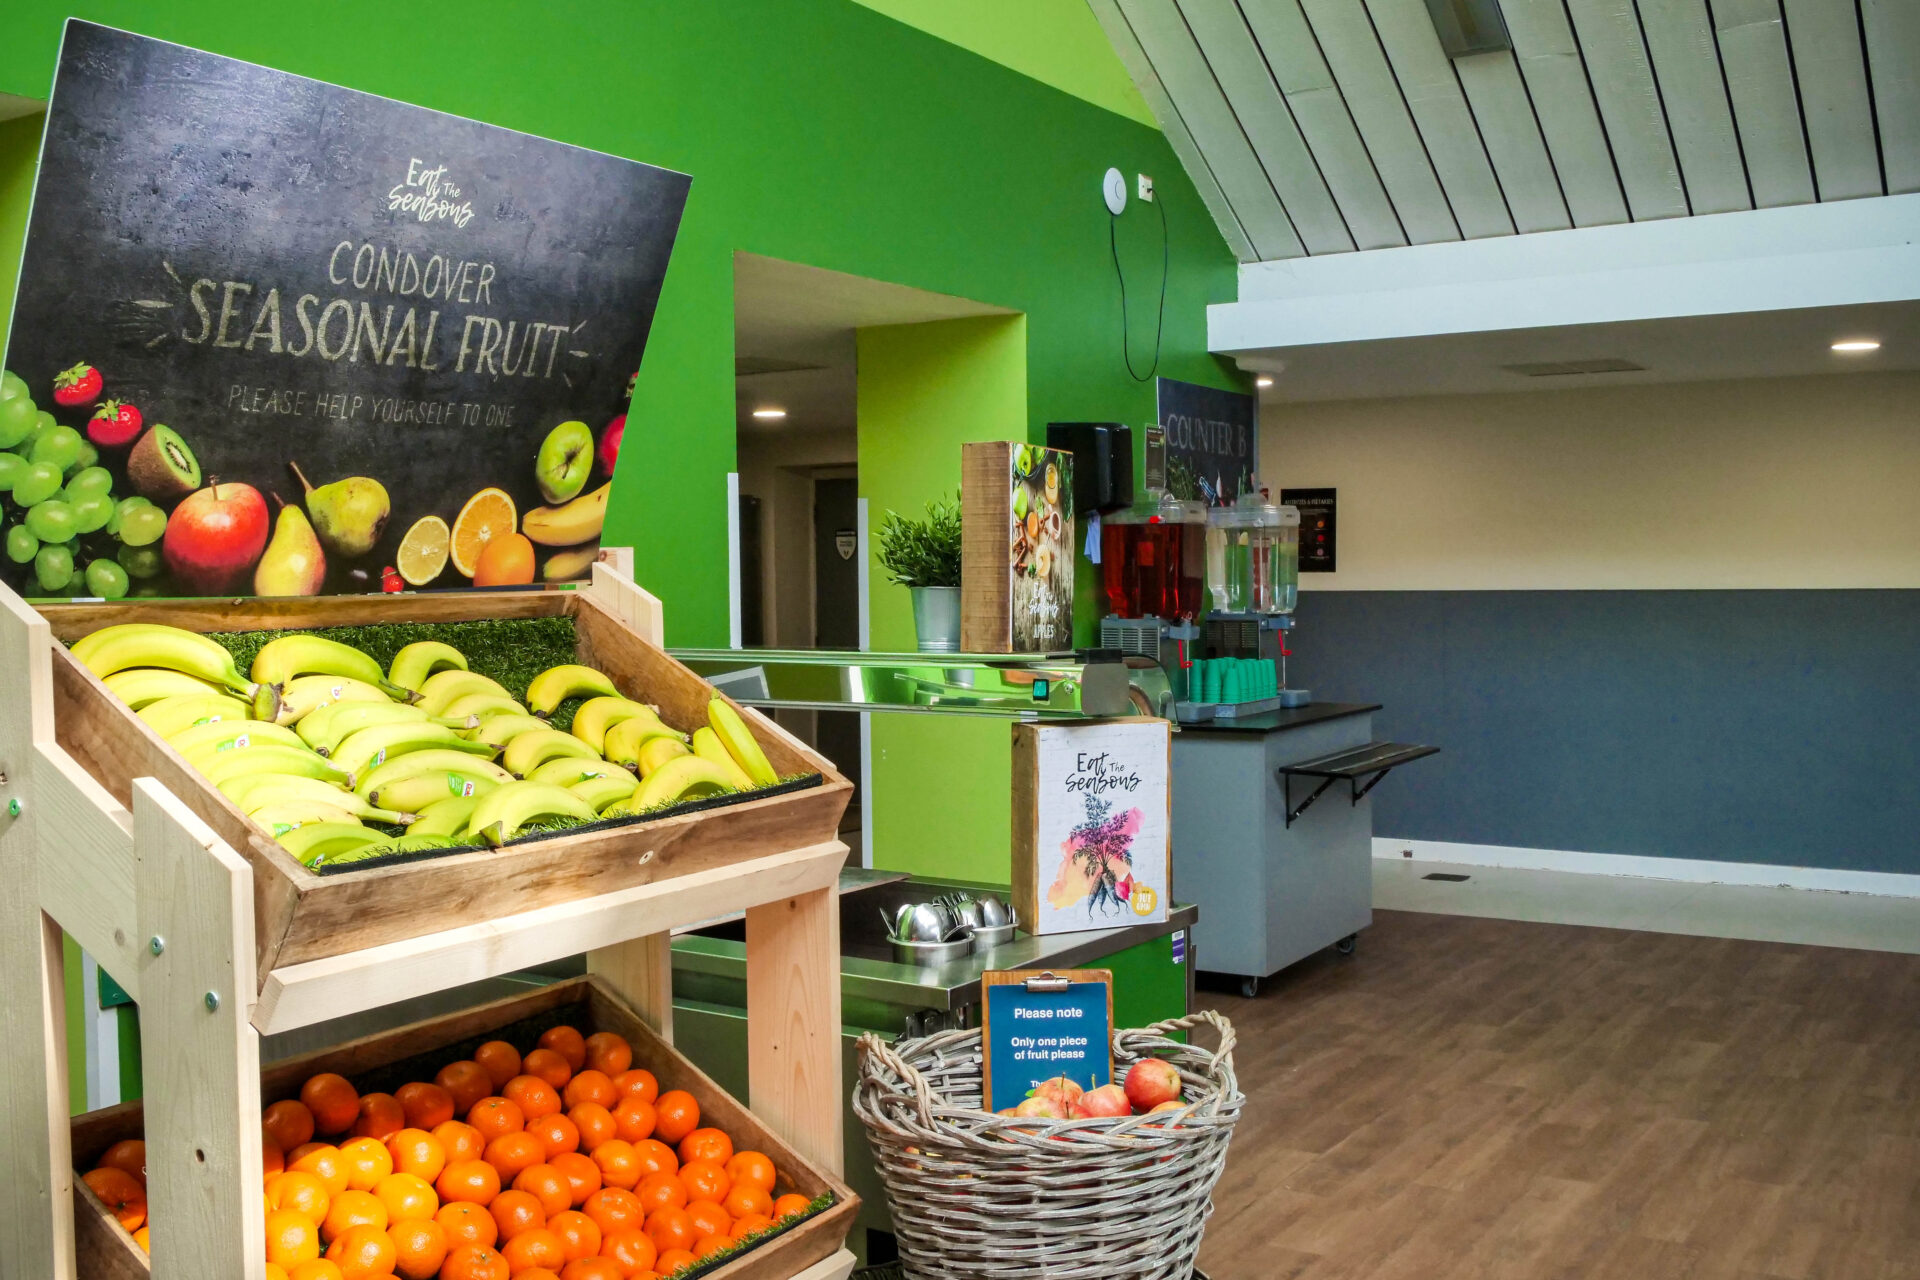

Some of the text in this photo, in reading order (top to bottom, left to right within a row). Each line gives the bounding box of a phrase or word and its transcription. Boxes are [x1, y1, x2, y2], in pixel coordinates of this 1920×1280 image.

[406, 157, 461, 198] Eat The
[329, 240, 496, 305] CONDOVER
[182, 278, 569, 379] SEASONAL FRUIT
[228, 384, 515, 428] PLEASE HELP YOURSELF TO ONE
[1167, 413, 1247, 457] COUNTER B
[1077, 752, 1126, 776] Eat The
[1014, 1007, 1083, 1019] Please note
[1011, 1036, 1088, 1049] Only one piece
[1014, 1049, 1085, 1061] of fruit please
